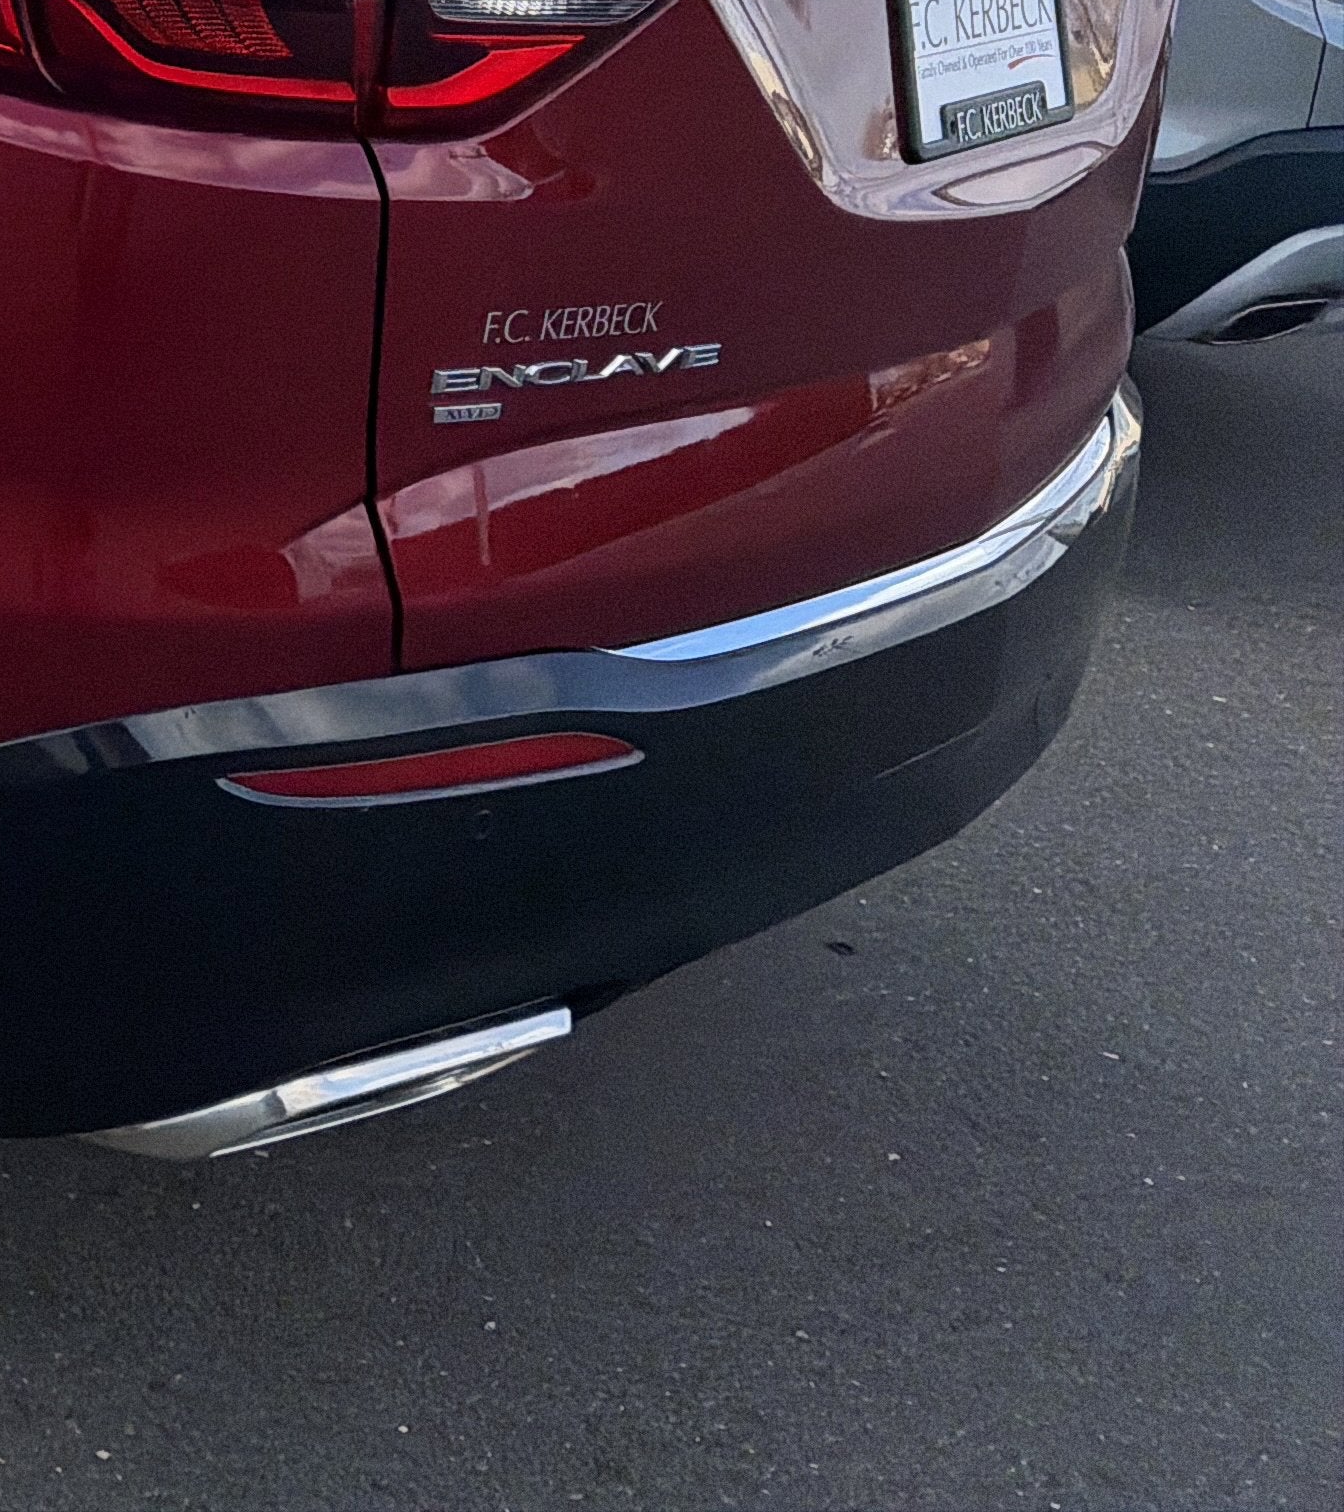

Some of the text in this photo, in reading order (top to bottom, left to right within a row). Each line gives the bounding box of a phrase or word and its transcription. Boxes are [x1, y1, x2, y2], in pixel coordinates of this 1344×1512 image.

[957, 91, 1043, 143] F.C. KERBECK
[482, 300, 664, 344] F.C. KERBECK
[431, 343, 723, 394] ENCLAVE
